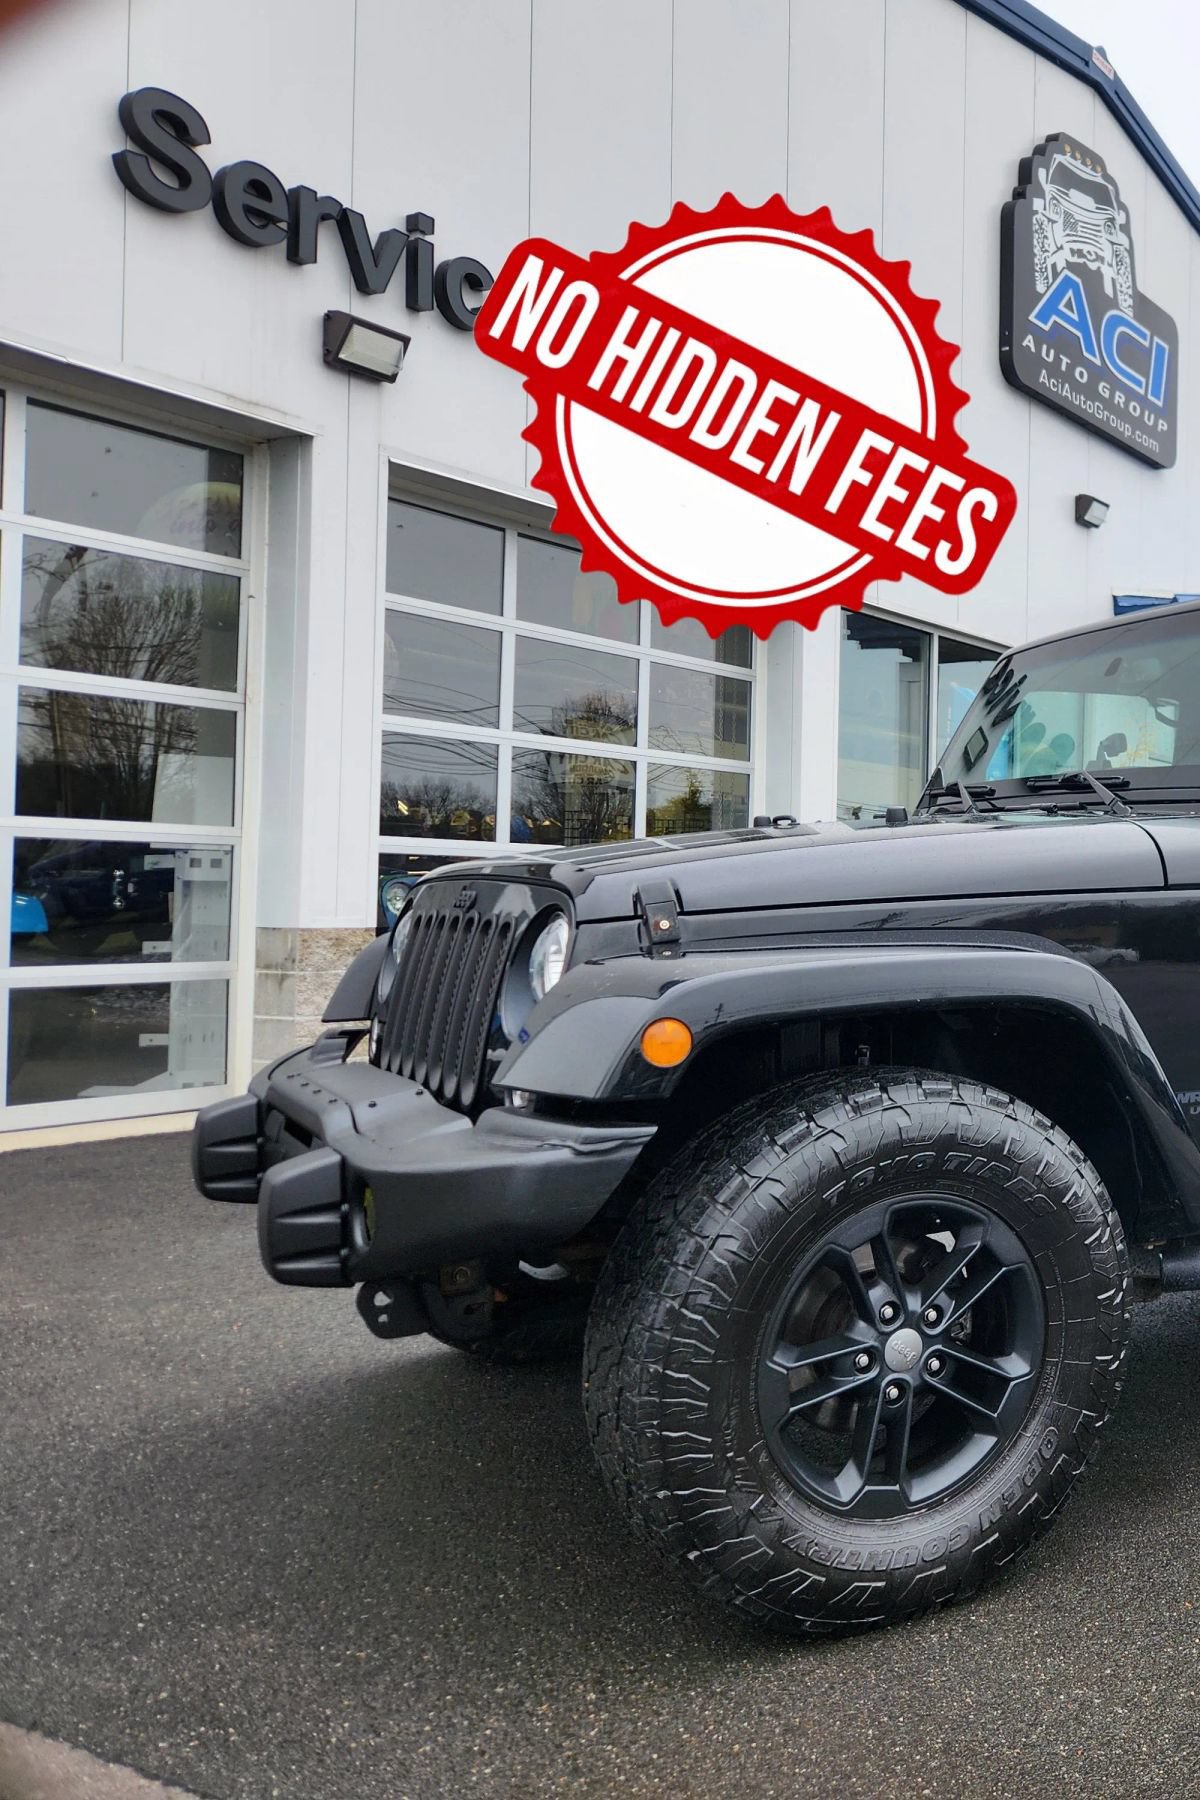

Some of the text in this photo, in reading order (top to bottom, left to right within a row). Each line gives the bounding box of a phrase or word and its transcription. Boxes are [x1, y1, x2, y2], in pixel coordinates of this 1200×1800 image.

[112, 87, 496, 331] Servic
[1022, 334, 1168, 432] AUTO GROUP
[1028, 268, 1169, 407] ACI
[1039, 369, 1159, 453] AciAutoGroup.com
[822, 1151, 936, 1209] TOYO
[781, 1522, 972, 1572] COUNTRY
